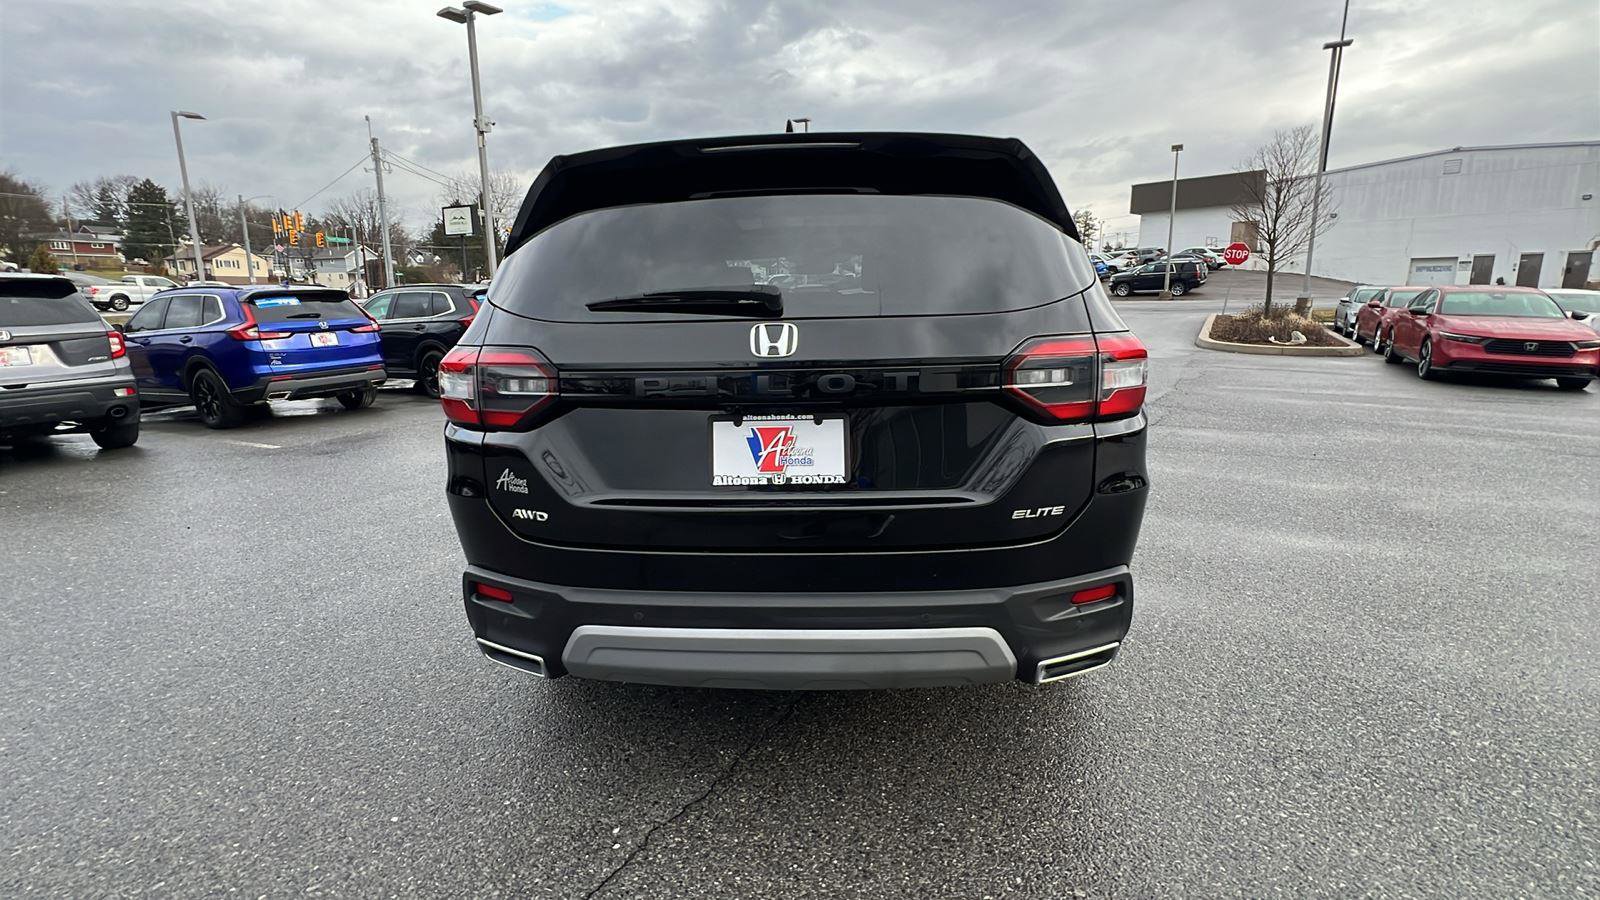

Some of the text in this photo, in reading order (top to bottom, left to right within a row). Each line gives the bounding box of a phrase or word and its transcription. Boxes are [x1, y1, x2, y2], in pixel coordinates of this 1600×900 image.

[1225, 249, 1249, 259] STOP
[634, 371, 920, 397] PILOT
[780, 456, 814, 466] Honda
[712, 474, 769, 486] Altoona
[790, 475, 847, 485] HONDA
[512, 508, 549, 522] AWD
[1011, 505, 1066, 519] ELITE
